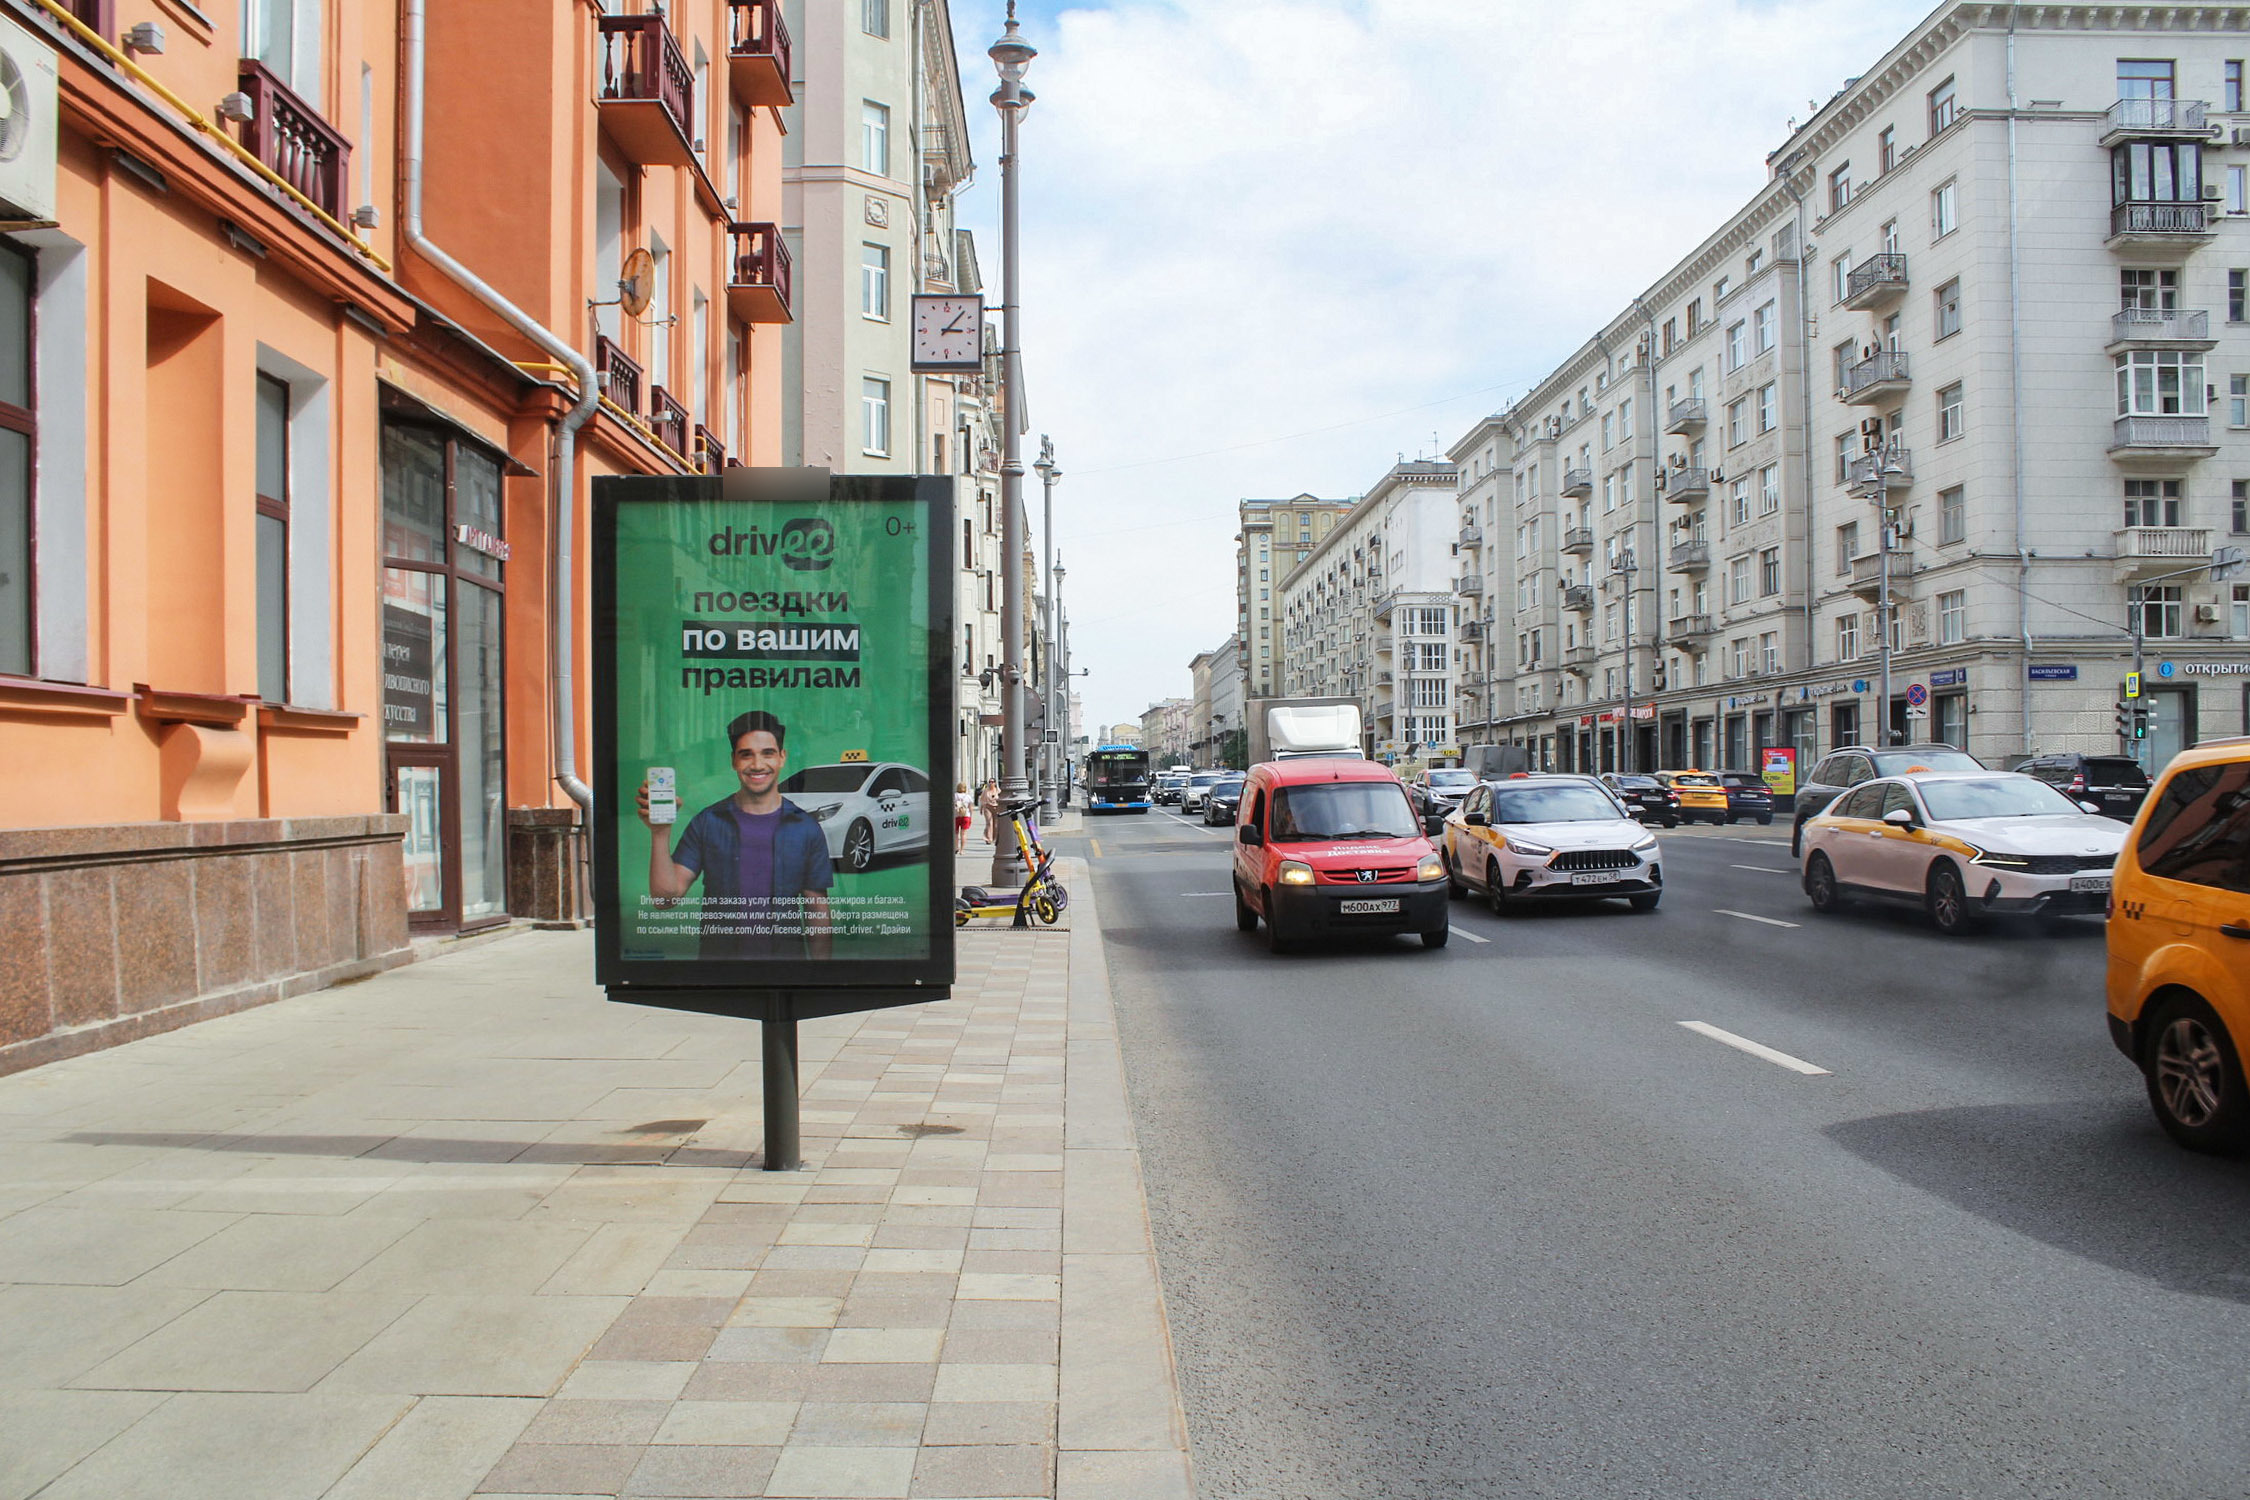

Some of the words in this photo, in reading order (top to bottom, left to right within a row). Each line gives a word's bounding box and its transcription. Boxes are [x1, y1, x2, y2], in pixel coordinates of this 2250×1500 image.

[886, 516, 915, 536] 0+
[708, 518, 834, 571] drivee
[694, 591, 848, 617] поездки
[683, 629, 726, 651] по
[737, 629, 859, 651] вашим
[682, 667, 860, 696] правилам
[1327, 848, 1391, 857] Доставка
[640, 894, 666, 906] Drivee
[671, 897, 700, 907] сервис
[701, 896, 718, 906] для
[719, 896, 747, 905] заказа
[748, 896, 771, 907] услуг
[772, 896, 815, 907] перевозки
[816, 896, 865, 907] пассажиров
[874, 894, 906, 905] багажа.
[1342, 902, 1381, 912] М600АХ
[1381, 901, 1397, 909] 977
[638, 910, 649, 920] Не
[650, 911, 689, 920] является
[689, 911, 748, 921] перевозчиком
[749, 911, 765, 920] или
[766, 909, 802, 921] службой
[803, 911, 829, 920] такси.
[830, 909, 860, 921] Оферта
[861, 910, 909, 921] размещена
[637, 926, 647, 935] по
[648, 926, 679, 935] ссылке
